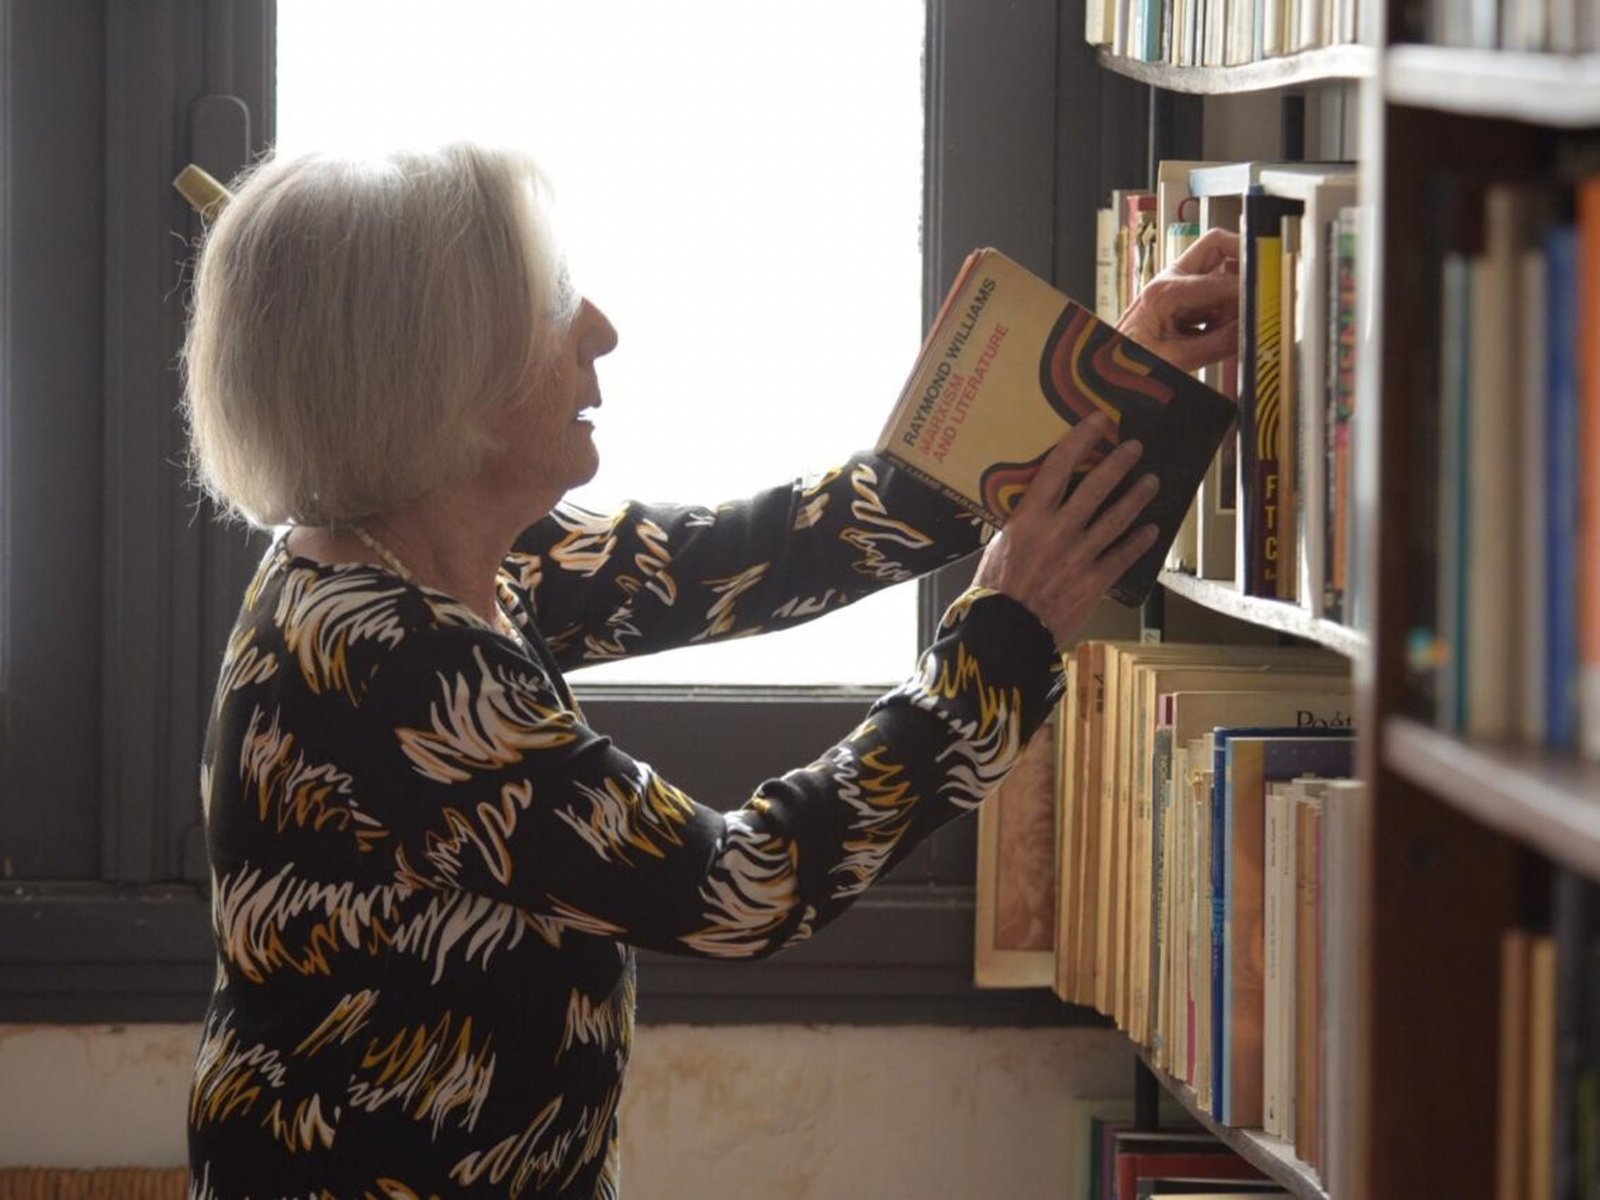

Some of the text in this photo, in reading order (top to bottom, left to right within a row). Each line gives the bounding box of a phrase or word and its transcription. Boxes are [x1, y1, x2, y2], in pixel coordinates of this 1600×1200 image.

[903, 278, 996, 446] RAYMOND WILLIAMS
[919, 372, 965, 456] MARXISM
[933, 322, 1009, 464] AND LITERATURE
